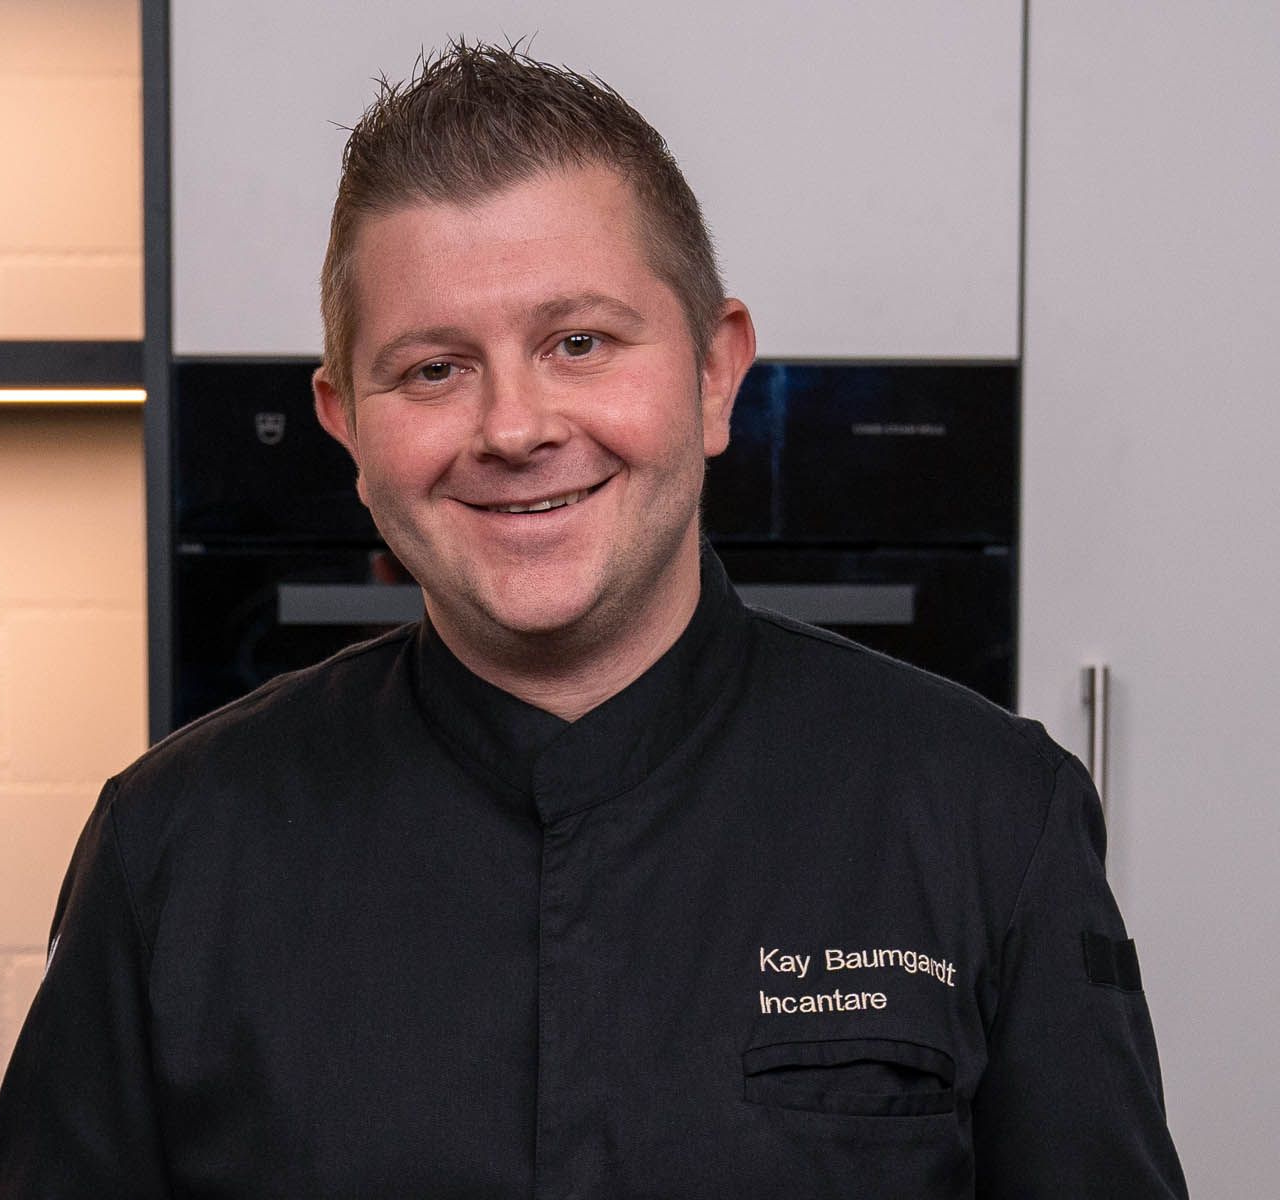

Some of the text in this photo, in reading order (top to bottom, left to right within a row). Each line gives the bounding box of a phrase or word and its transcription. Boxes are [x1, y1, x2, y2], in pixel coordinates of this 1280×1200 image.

[760, 947, 957, 987] Kay Baumgardt
[760, 989, 888, 1014] Incantare
